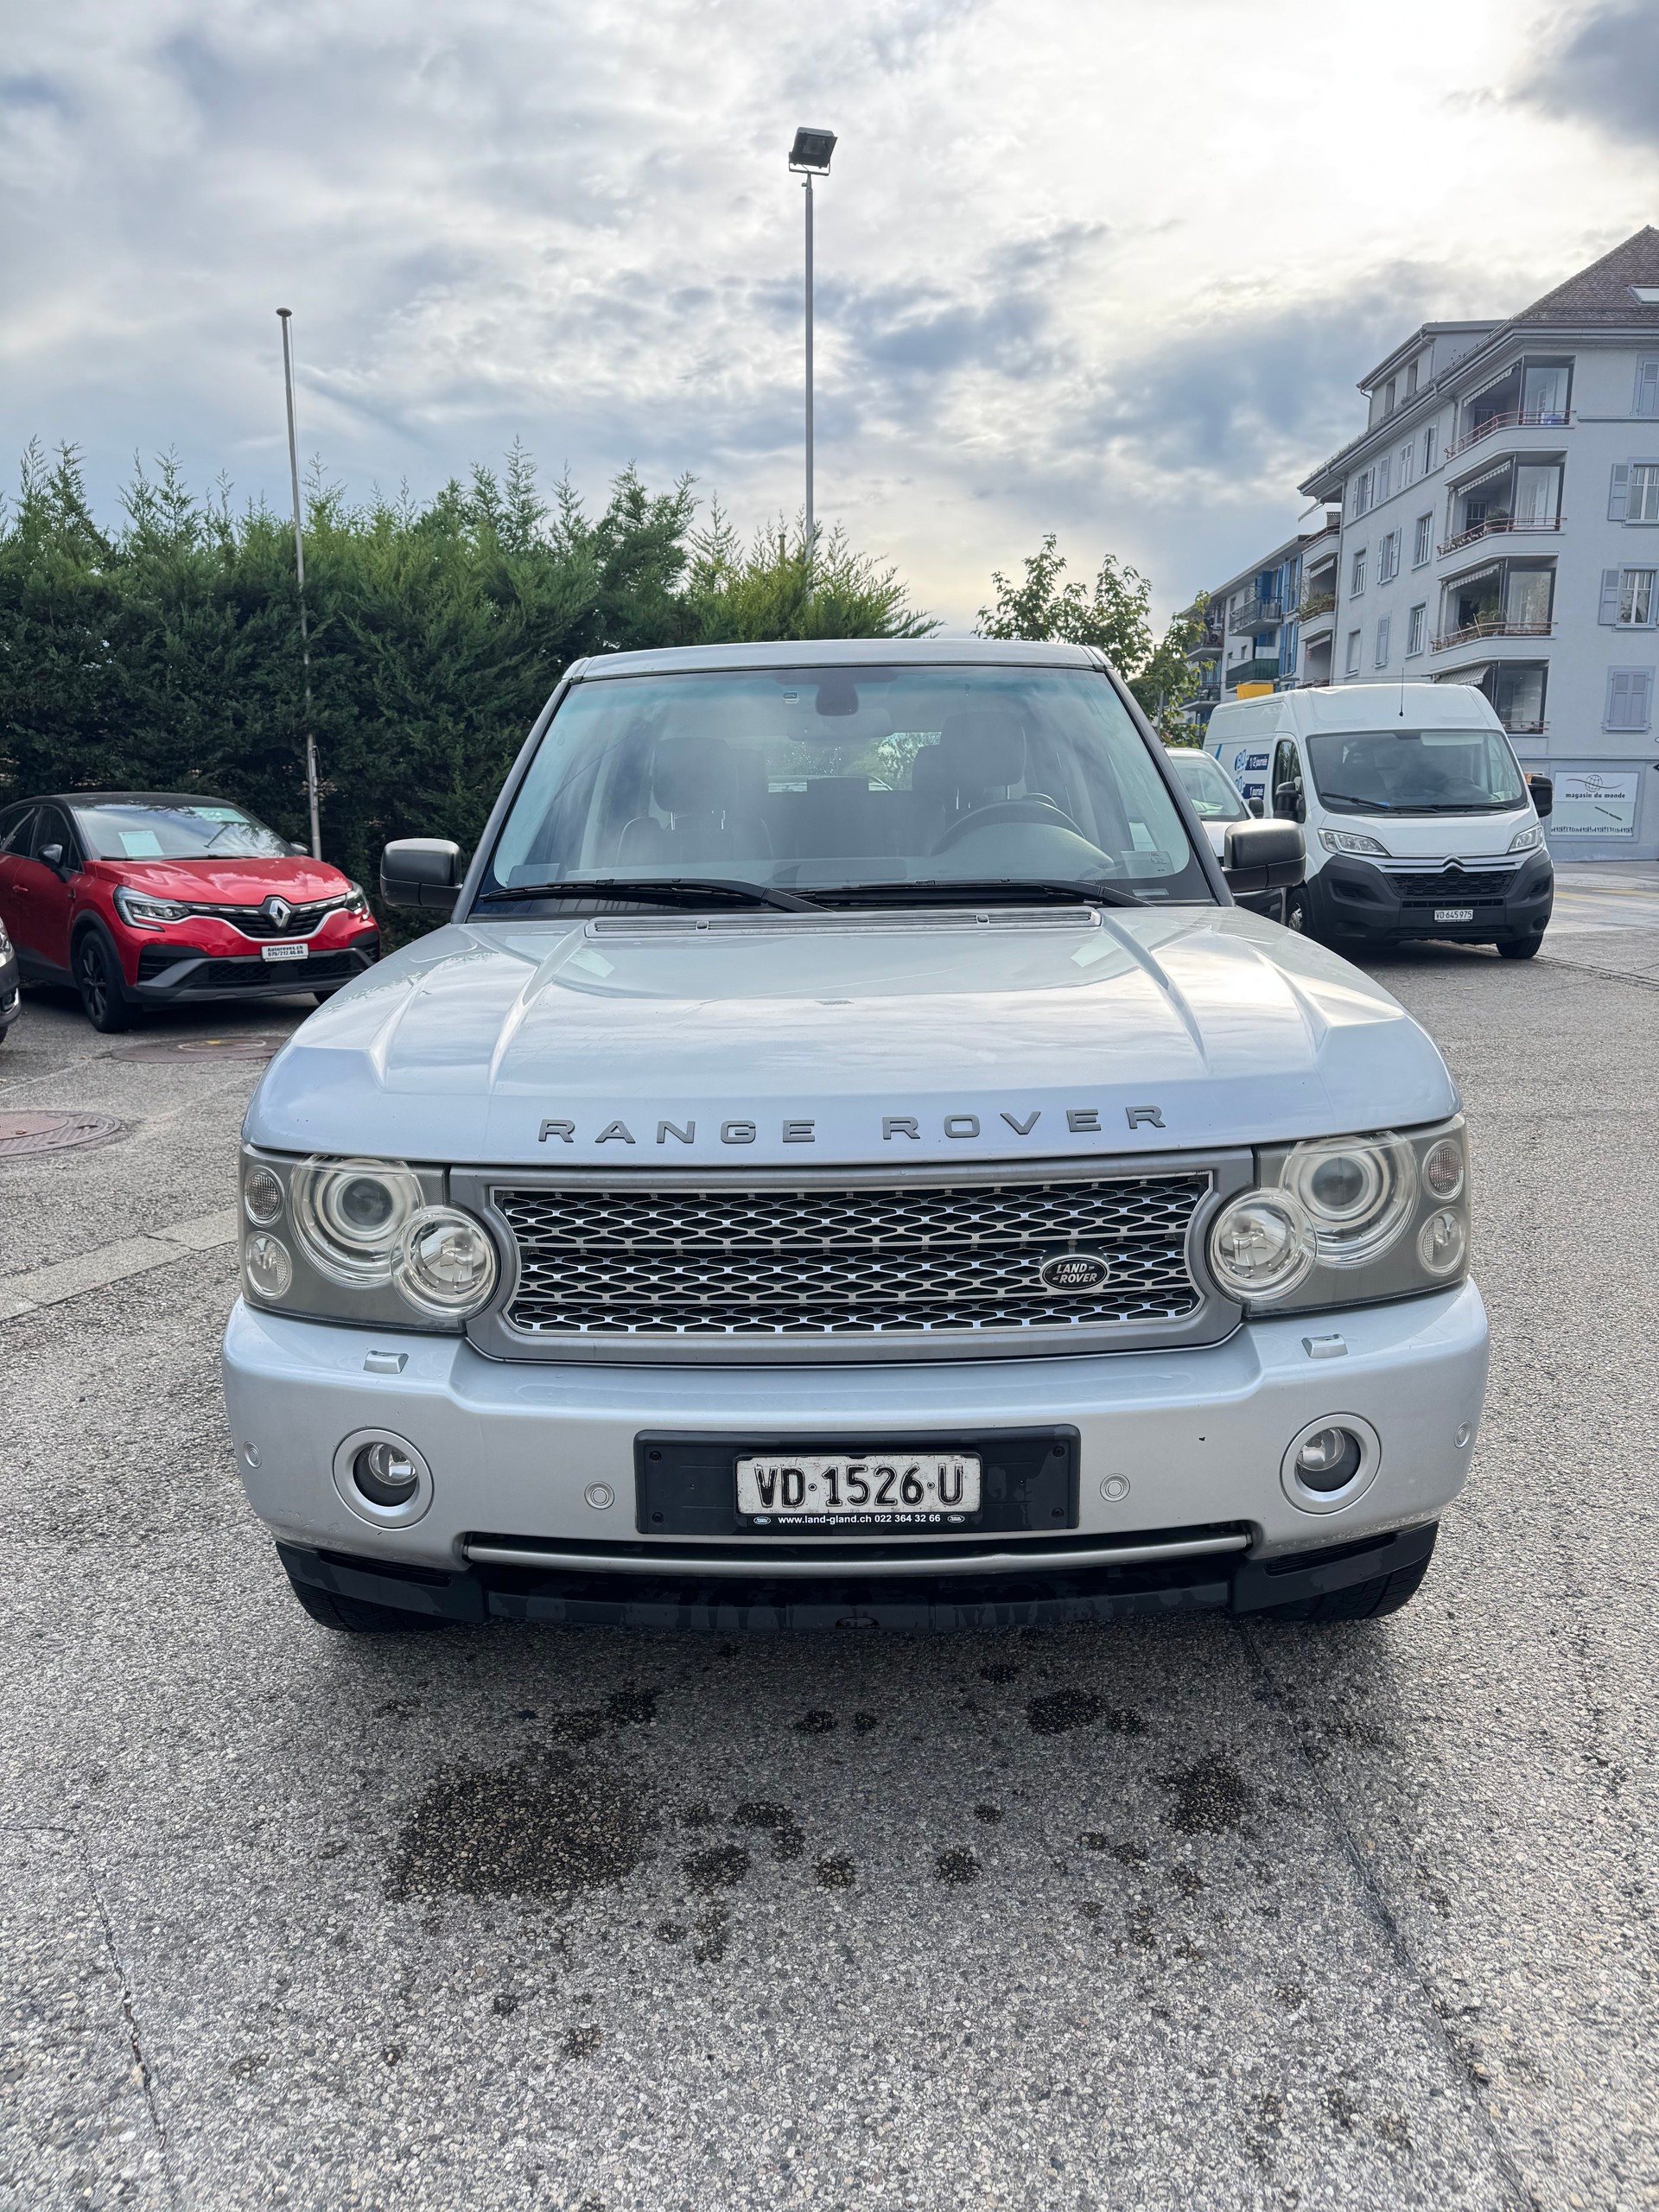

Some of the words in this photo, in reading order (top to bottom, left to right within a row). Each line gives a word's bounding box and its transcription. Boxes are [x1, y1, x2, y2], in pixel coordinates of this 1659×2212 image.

[538, 1119, 815, 1144] RANGE
[881, 1105, 1166, 1140] ROVER
[1056, 1263, 1088, 1274] LAND
[1058, 1273, 1097, 1284] ROVER
[778, 1515, 872, 1525] www.land-gland.ch
[929, 1514, 941, 1522] 66
